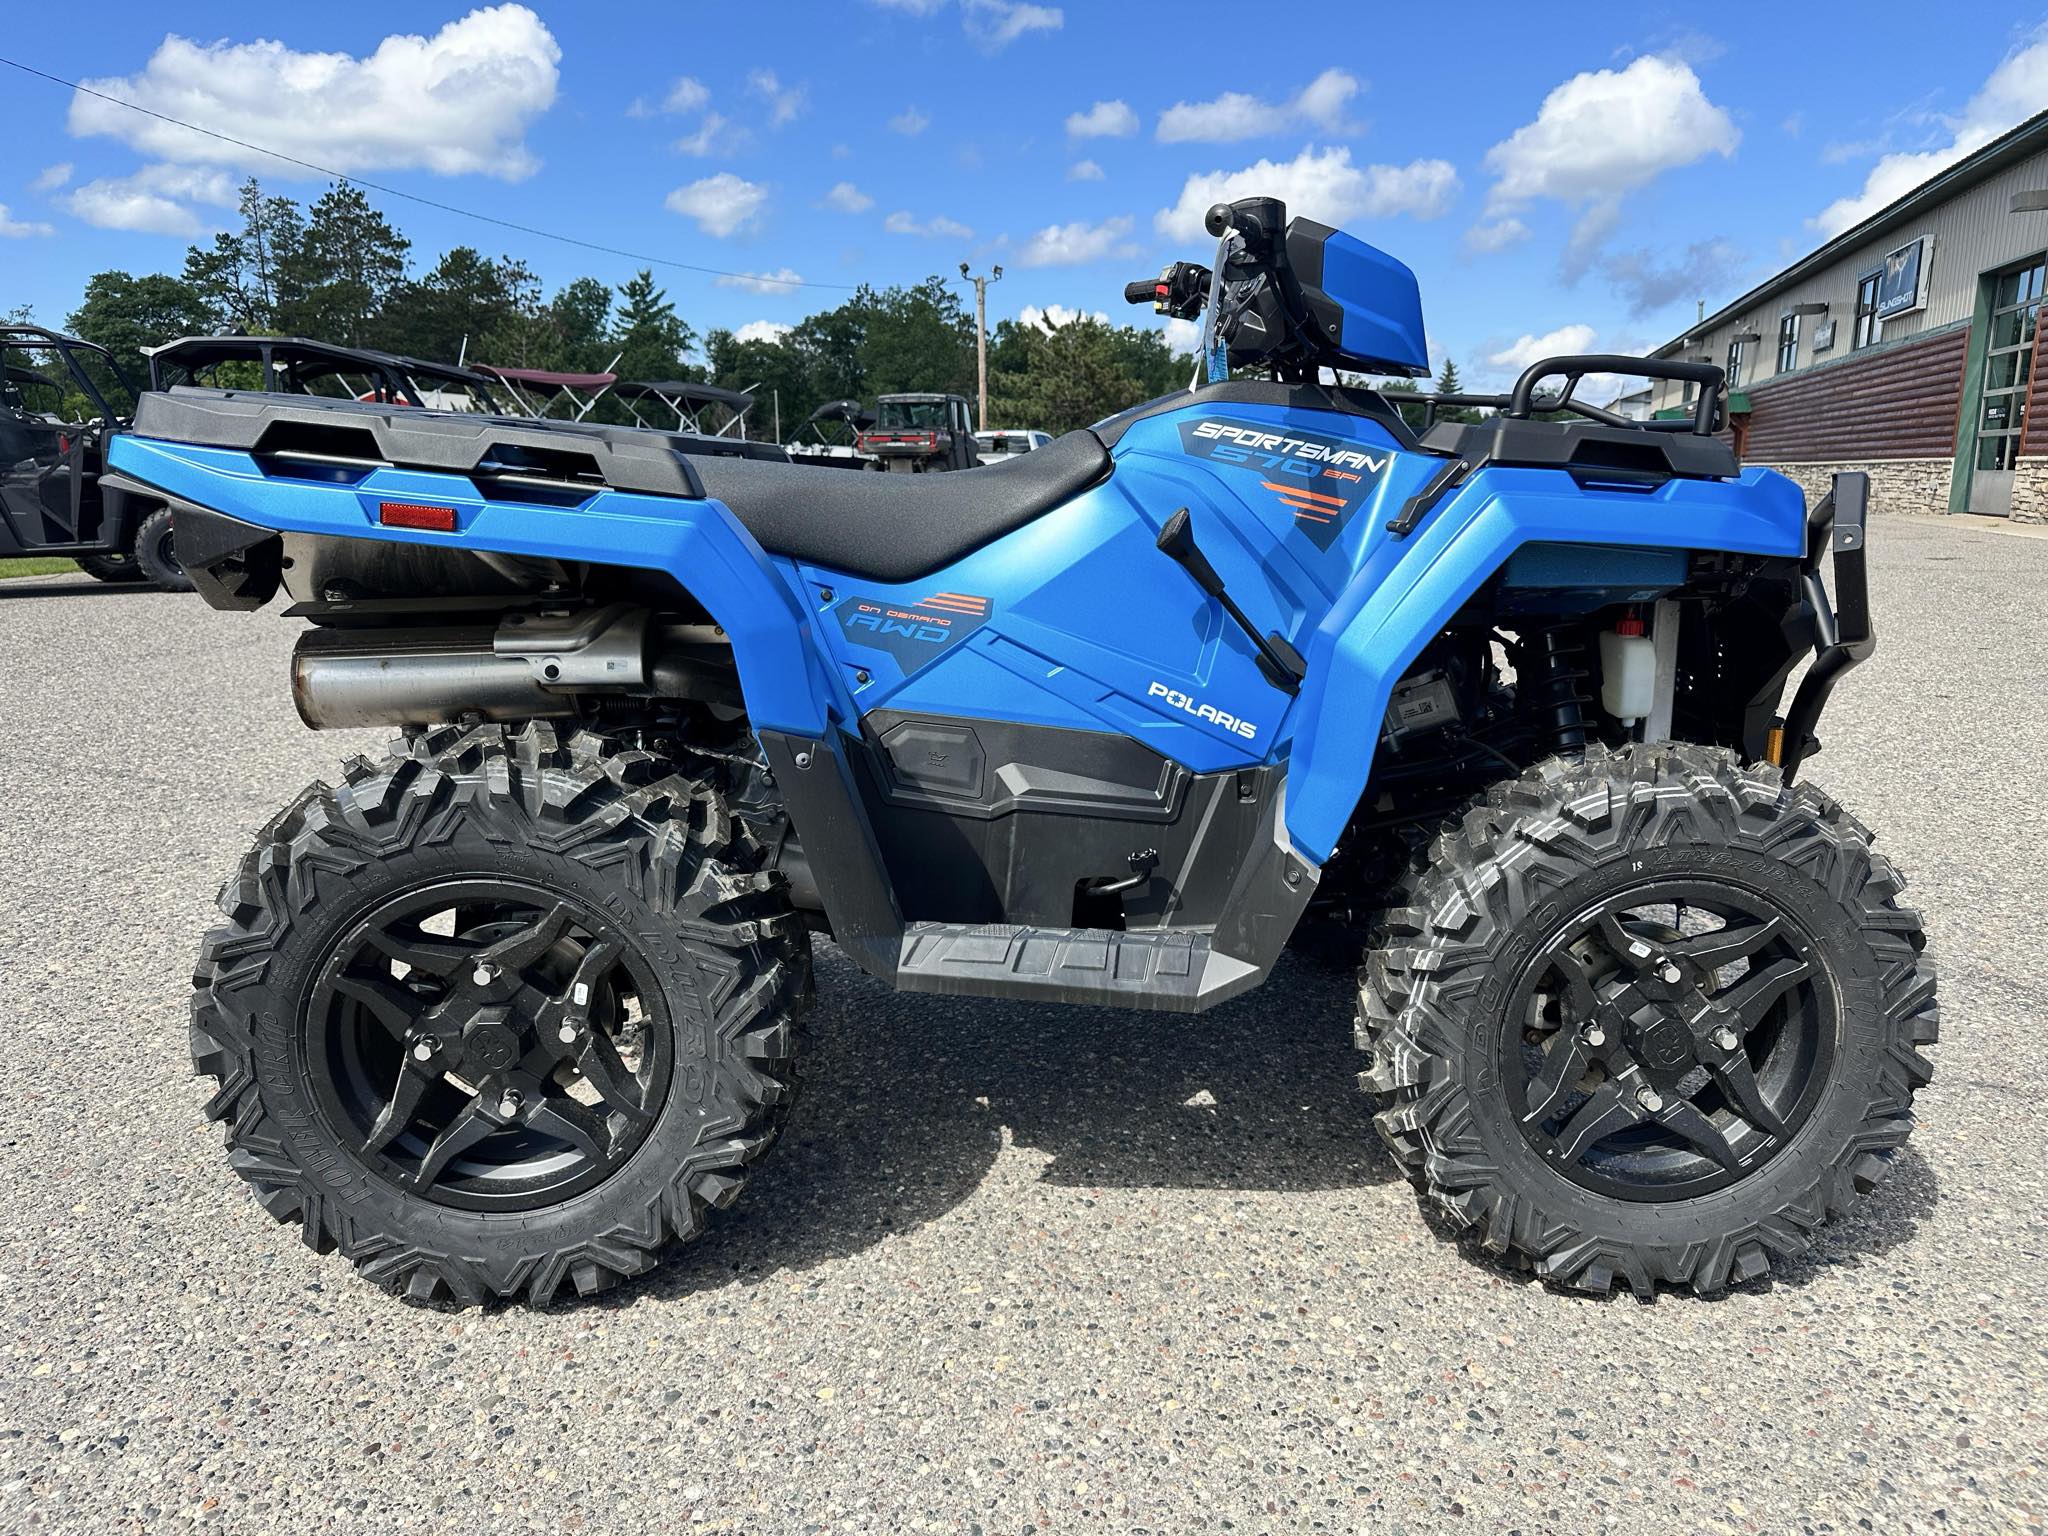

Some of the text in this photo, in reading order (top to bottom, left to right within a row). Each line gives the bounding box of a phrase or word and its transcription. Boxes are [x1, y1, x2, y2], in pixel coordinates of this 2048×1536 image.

[1879, 291, 1912, 312] SLINGSHOT
[1192, 422, 1387, 474] SPORTSMAN
[1210, 444, 1361, 484] 570 EFI
[845, 614, 950, 643] AWD
[858, 604, 952, 626] ON DEMAND
[1147, 681, 1257, 740] POLARIS
[262, 1011, 377, 1206] POWER GRIP
